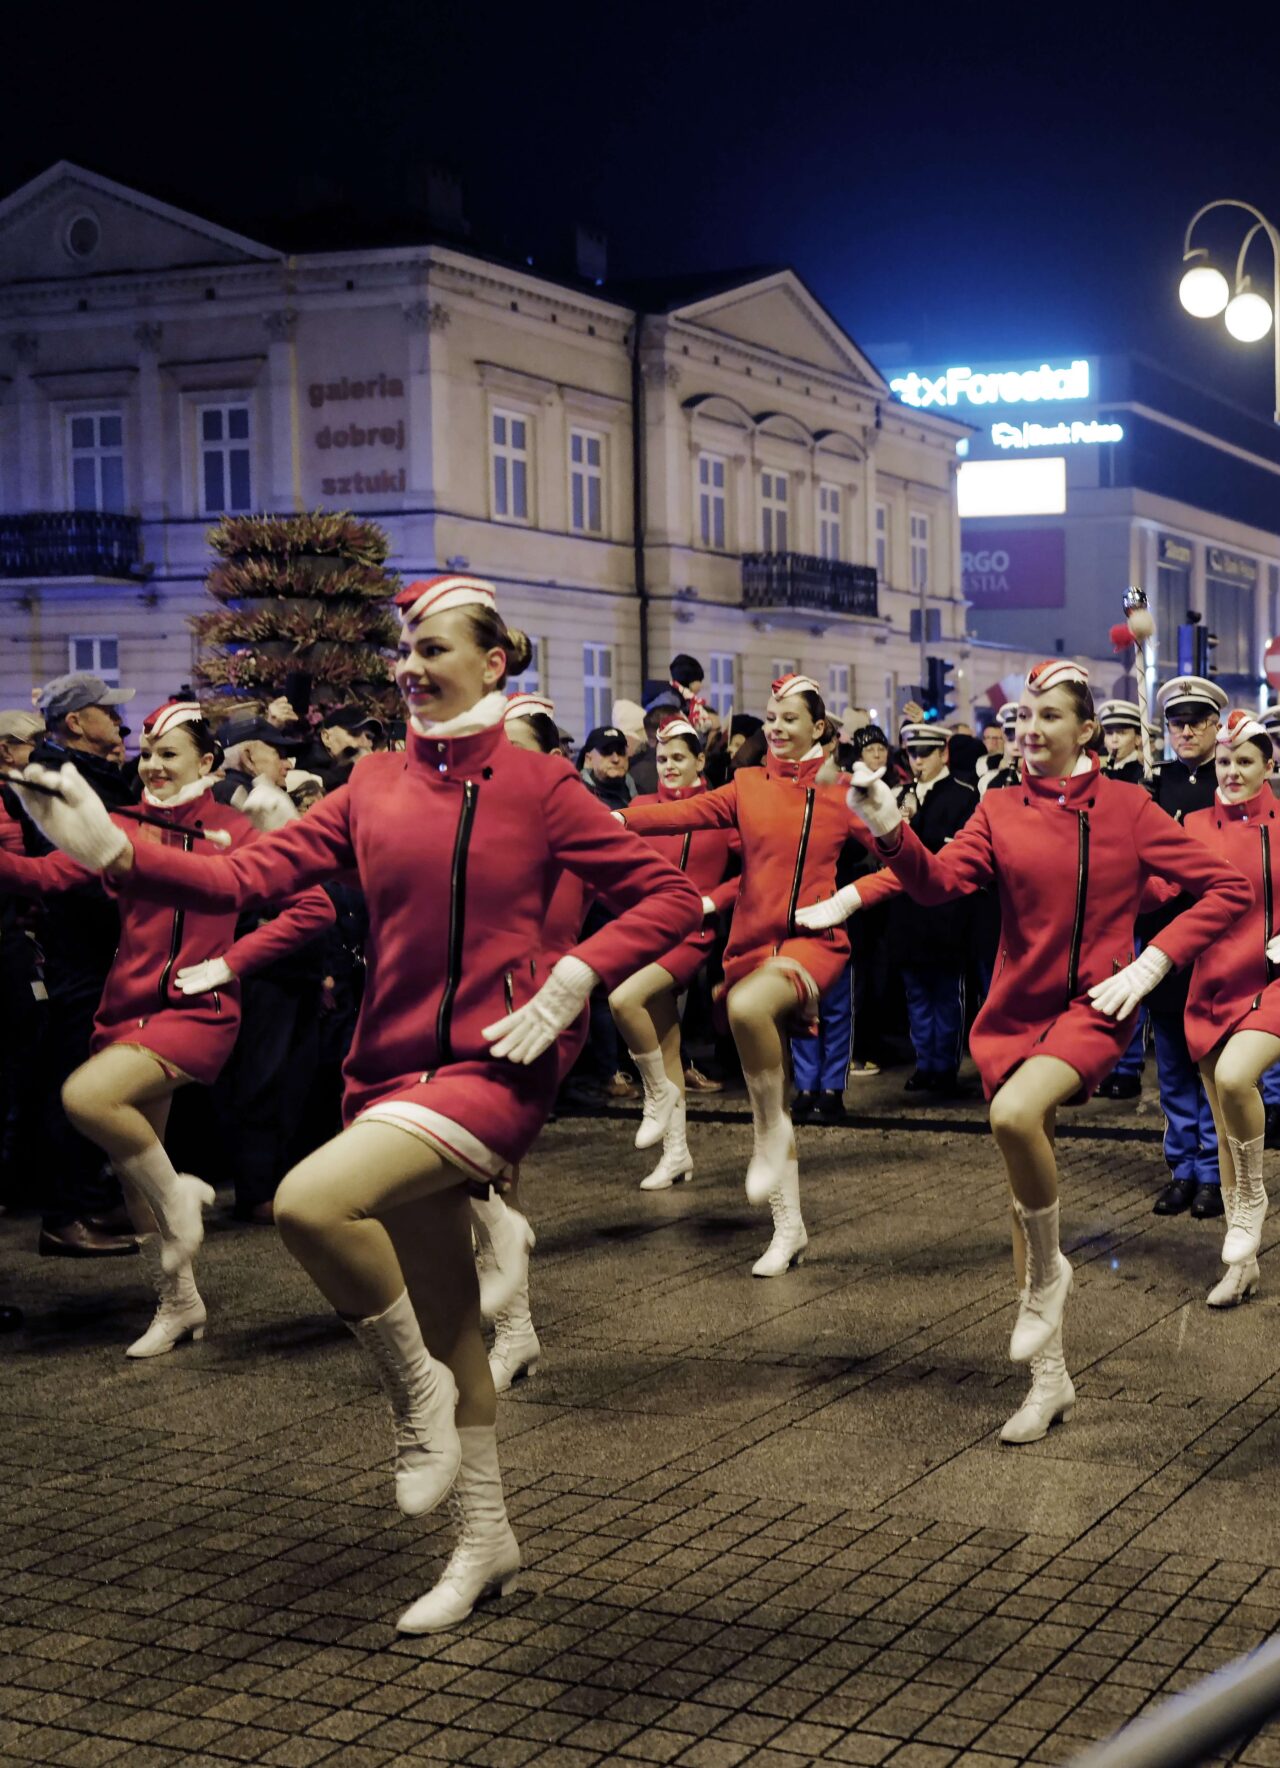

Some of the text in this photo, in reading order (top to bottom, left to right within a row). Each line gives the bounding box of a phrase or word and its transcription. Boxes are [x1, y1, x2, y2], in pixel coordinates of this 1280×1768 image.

[308, 373, 404, 408] galeria
[315, 419, 405, 451] dobrej
[321, 468, 406, 495] sztuki
[961, 549, 1010, 573] RGO
[962, 573, 1010, 593] ESTIA
